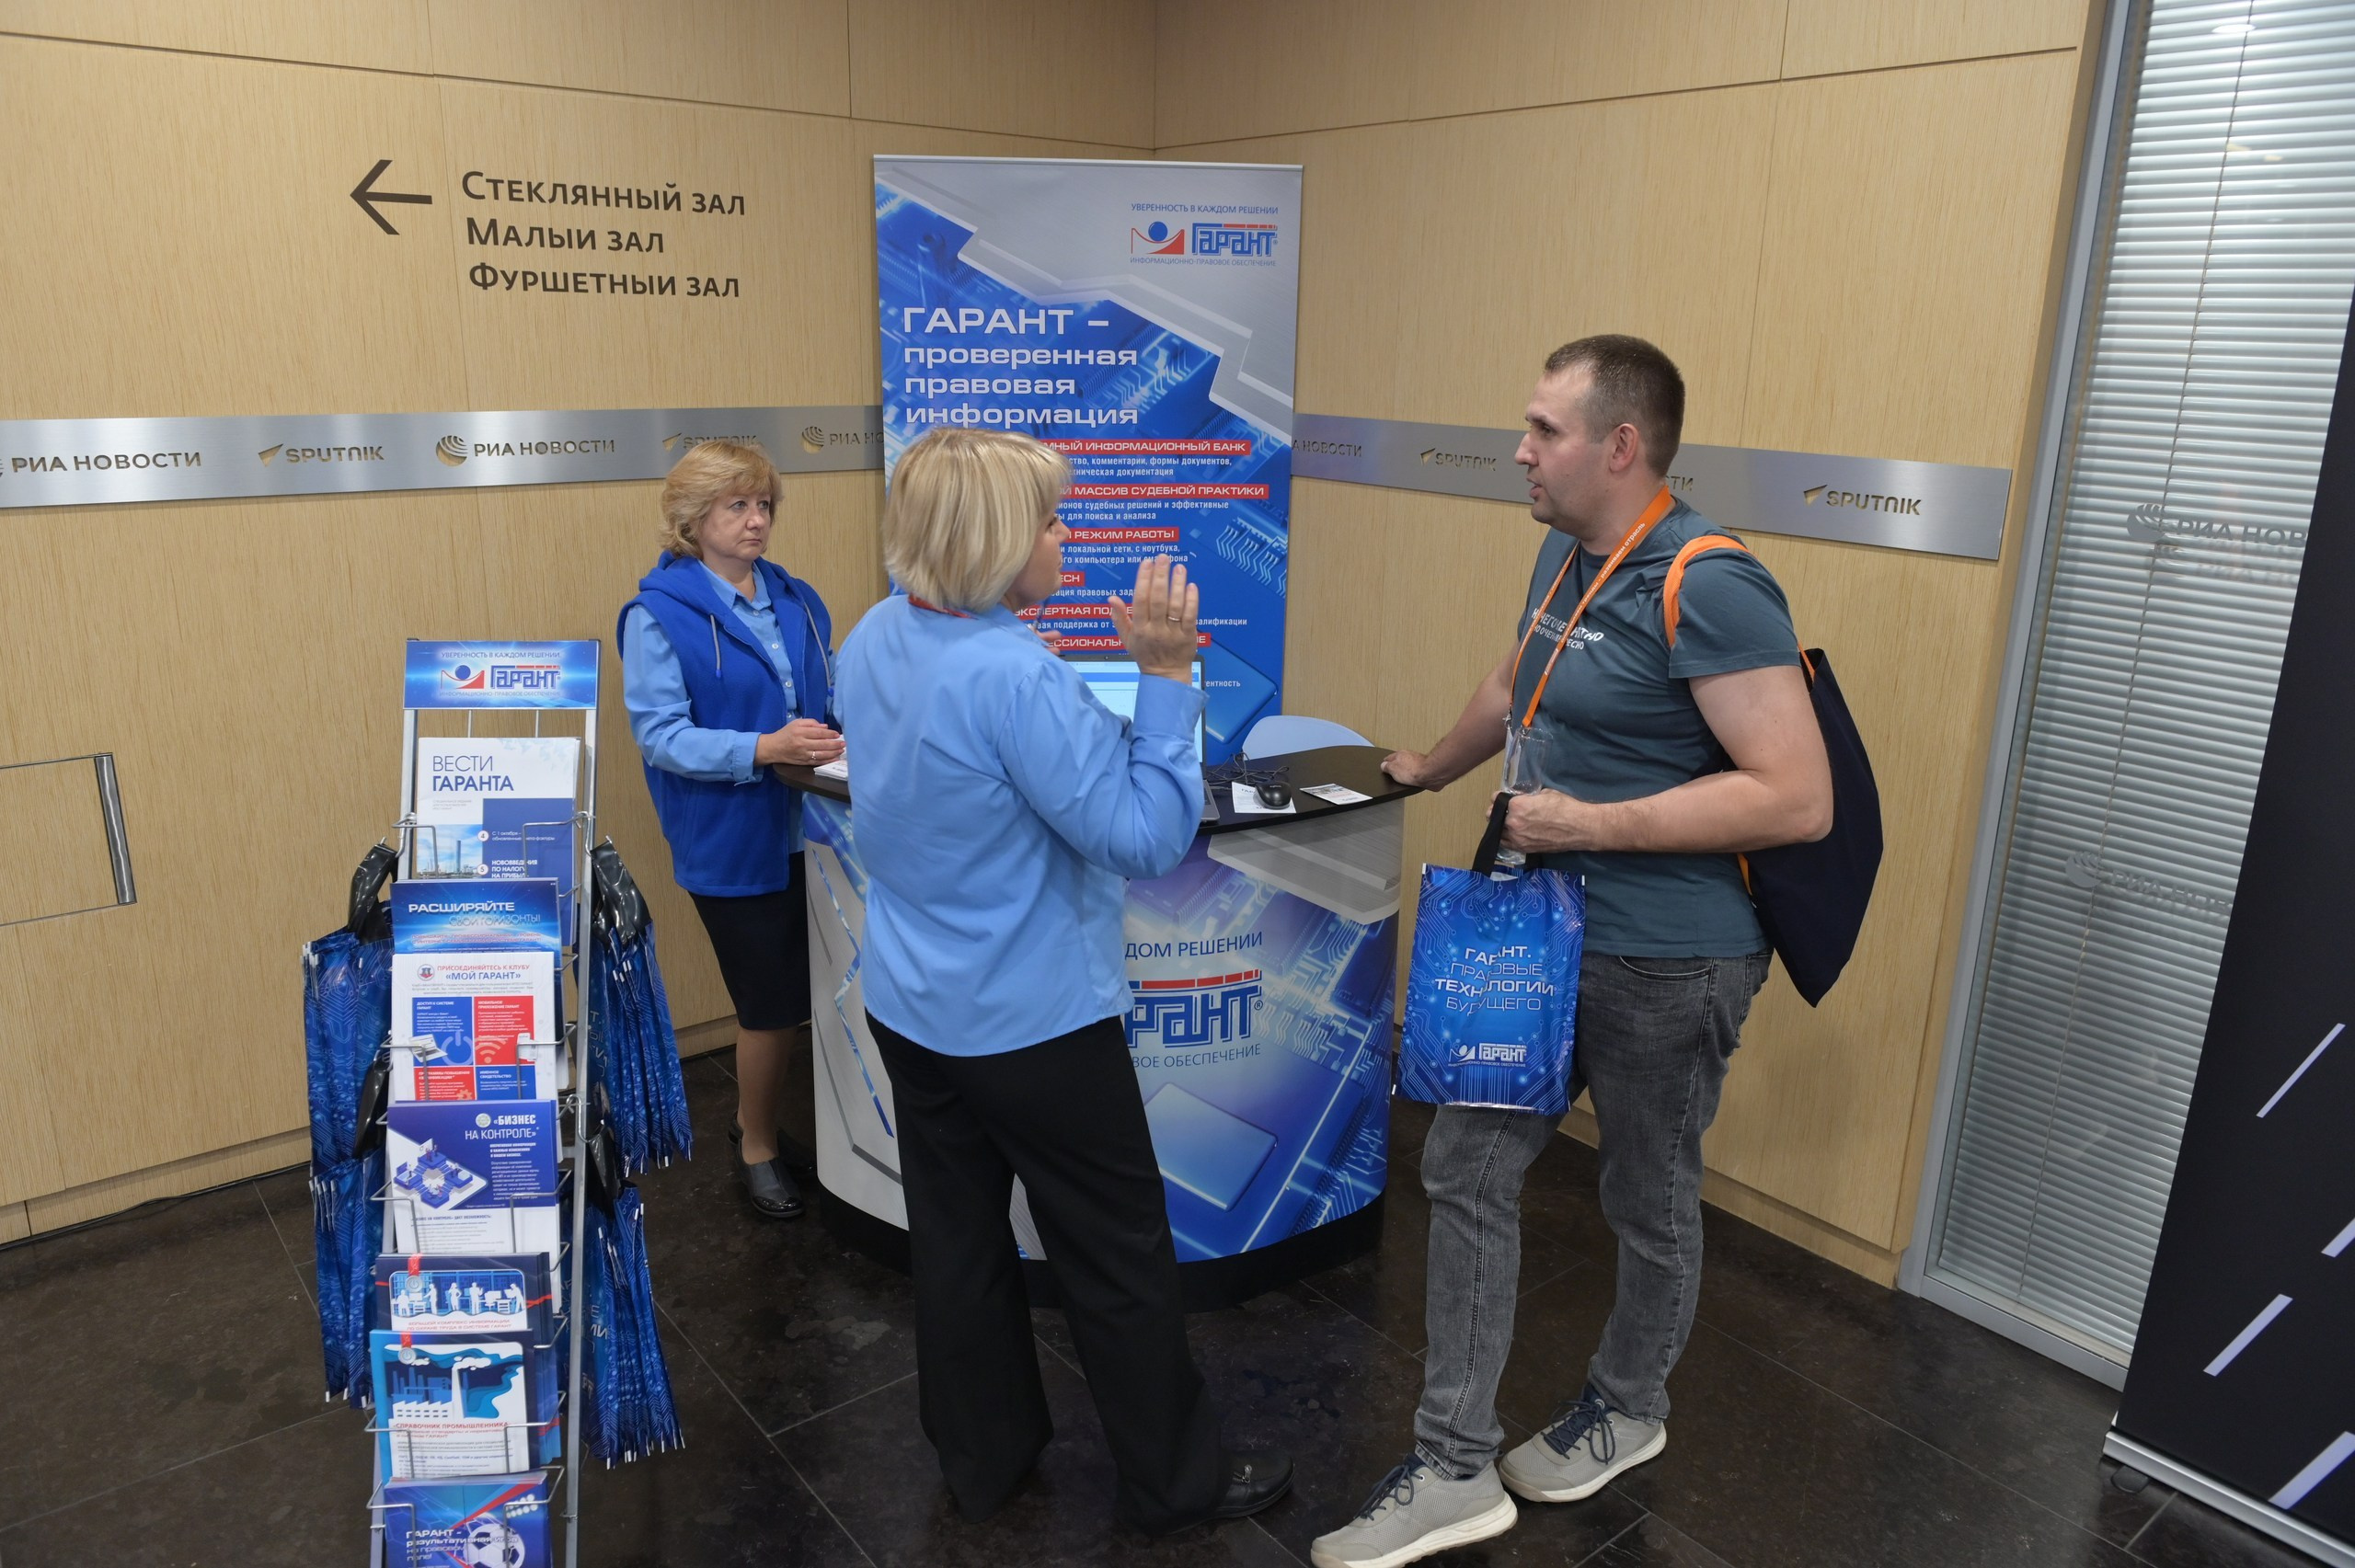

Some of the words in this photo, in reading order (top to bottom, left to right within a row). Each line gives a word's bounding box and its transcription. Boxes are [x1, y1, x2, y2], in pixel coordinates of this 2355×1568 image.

[692, 192, 745, 215] ЗАЛ
[1131, 203, 1189, 212] УВЕРЕННОСТЬ
[1198, 205, 1236, 214] КАЖДОМ
[1238, 206, 1279, 214] РЕШЕНИИ
[607, 230, 663, 253] ЗАЛ
[686, 277, 740, 298] ЗАЛ
[903, 307, 1074, 335] ГАРАНТ
[904, 348, 1137, 369] проверенная
[905, 378, 1075, 398] правовая
[906, 403, 1138, 429] информация
[830, 432, 860, 446] РИА
[1086, 441, 1211, 452] ИНФОРМАЦИОННЫЙ
[1213, 443, 1246, 452] БАНК
[286, 446, 385, 464] SPUTNIK
[474, 441, 515, 458] РИА
[521, 439, 615, 456] НОВОСТИ
[1302, 439, 1362, 458] НОВОСТИ
[13, 456, 67, 473] РИА
[74, 452, 202, 471] НОВОСТИ
[1091, 458, 1148, 466] комментарии,
[1150, 457, 1179, 465] формы
[1181, 457, 1232, 466] документов,
[1435, 452, 1498, 472] SPUTNIK
[1116, 468, 1174, 477] документация
[1074, 486, 1128, 496] МАССИВ
[1131, 486, 1195, 497] СУДЕБНОЙ
[1198, 486, 1264, 495] ПРАКТИКИ
[1085, 501, 1124, 510] судебных
[1127, 501, 1162, 509] решений
[1171, 501, 1229, 510] эффективные
[1826, 490, 1922, 516] SPUTNIK
[1067, 513, 1083, 521] для
[1074, 531, 1122, 540] РЕЖИМ
[1126, 530, 1175, 539] РАБОТЫ
[1624, 521, 1646, 549] отрасль
[2177, 516, 2233, 541] РИА
[1067, 544, 1111, 554] локальной
[1113, 545, 1133, 554] сети,
[1142, 544, 1180, 554] ноутбука,
[1074, 555, 1124, 565] компьютера
[1053, 620, 1097, 629] поддержка
[432, 755, 493, 772] ВЕСТИ
[432, 775, 514, 792] ГАРАНТА
[408, 900, 515, 913] РАСШИРЯЙТЕ
[1124, 943, 1171, 960] ДОМ
[1178, 932, 1262, 957] РЕШЕНИИ
[445, 970, 477, 980] «МОЙ
[478, 971, 521, 979] ГАРАНТ»
[1132, 1056, 1160, 1068] ВОЕ
[1164, 1043, 1261, 1068] ОБЕСПЕЧЕНИЕ
[493, 1114, 536, 1125] «БИЗНЕС
[465, 1130, 478, 1140] НА
